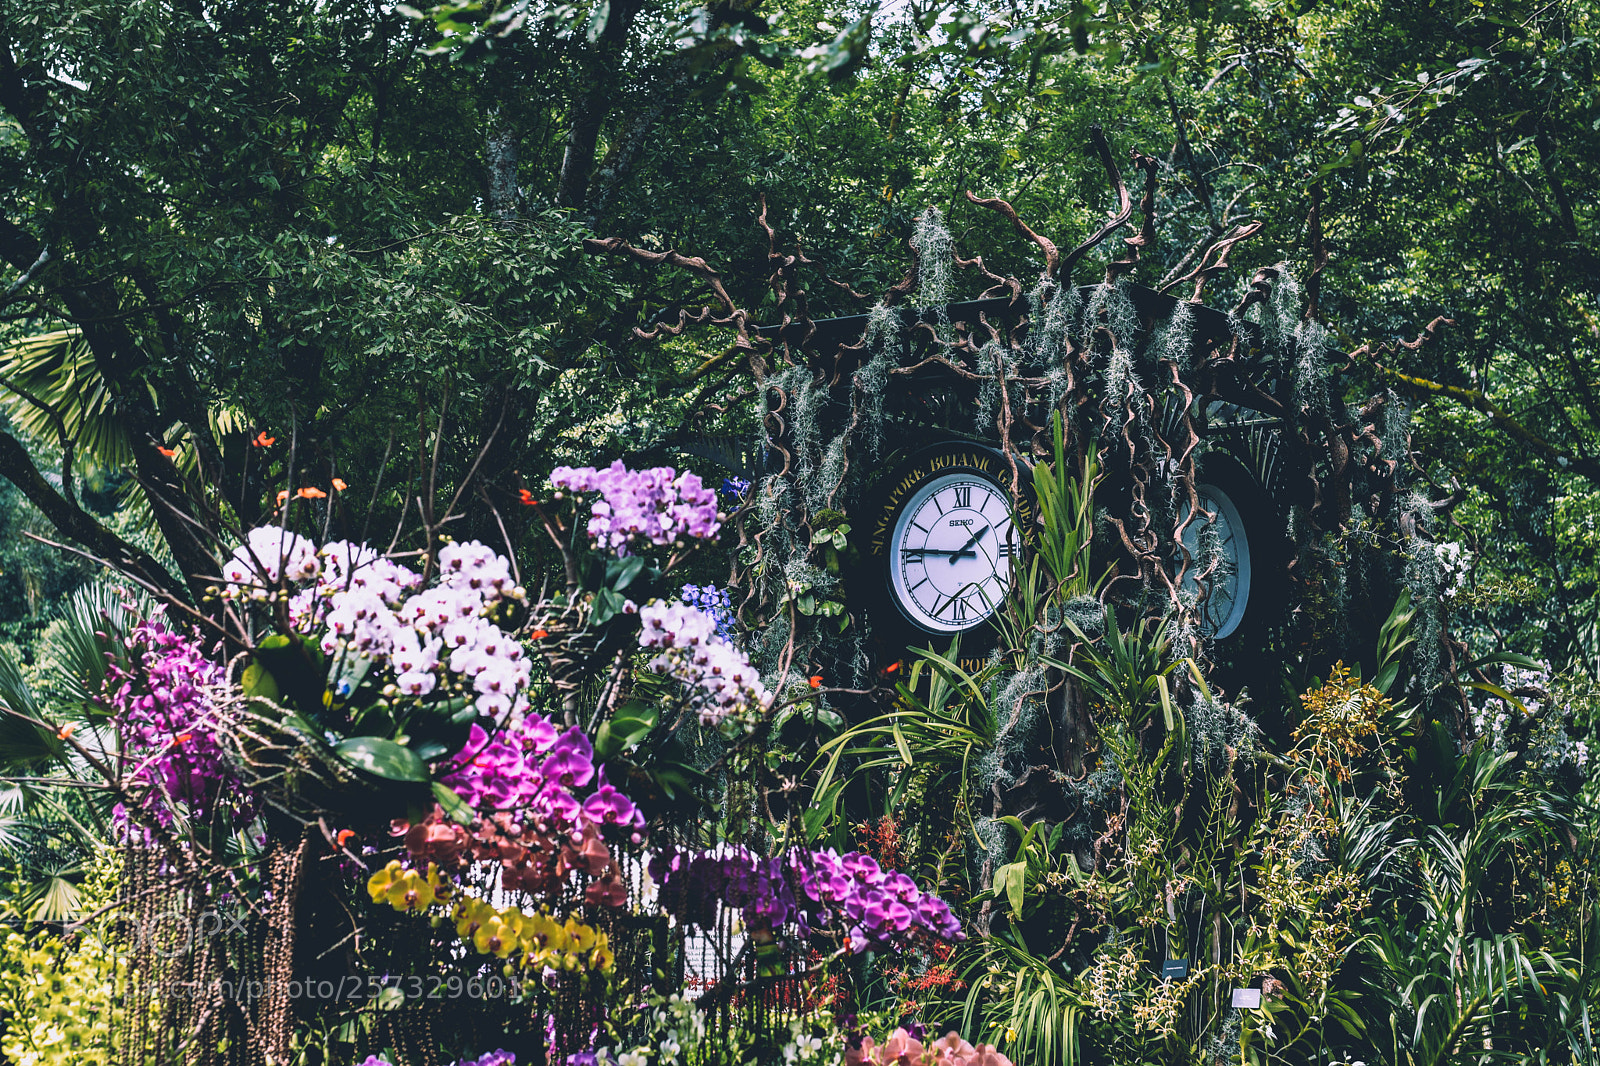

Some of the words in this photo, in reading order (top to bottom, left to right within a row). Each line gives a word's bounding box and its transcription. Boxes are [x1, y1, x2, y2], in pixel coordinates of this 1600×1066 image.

[872, 465, 925, 556] SINGAPORE
[930, 453, 993, 474] BOTANIC
[998, 469, 1035, 546] GDEN
[953, 486, 971, 508] XII
[949, 519, 974, 527] SEIKO
